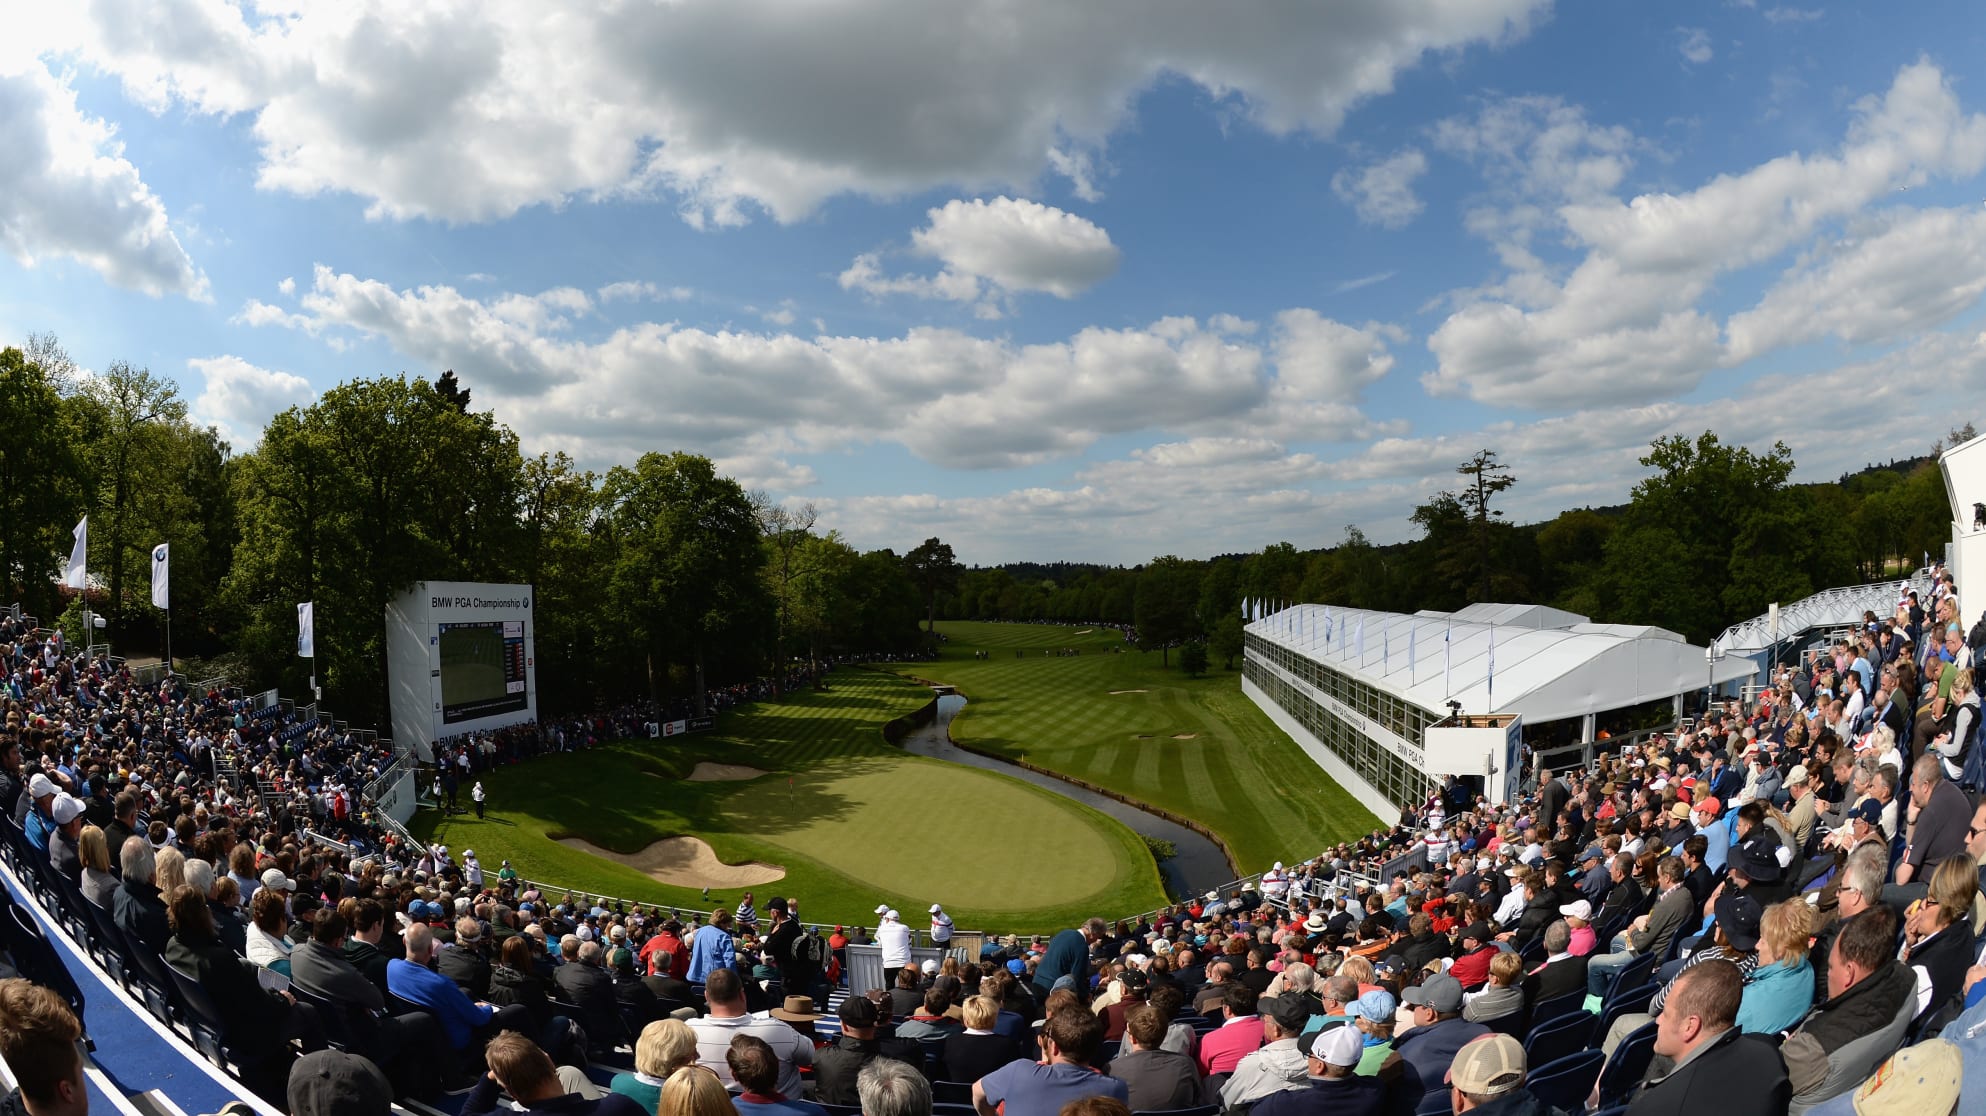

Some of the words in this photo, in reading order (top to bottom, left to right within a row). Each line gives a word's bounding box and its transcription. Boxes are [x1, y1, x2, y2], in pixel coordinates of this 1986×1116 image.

[432, 597, 453, 608] BMW
[455, 597, 472, 608] PGA
[473, 597, 521, 611] Championship
[439, 734, 459, 748] BMW
[1397, 742, 1408, 758] BMW
[1408, 749, 1419, 764] PGA
